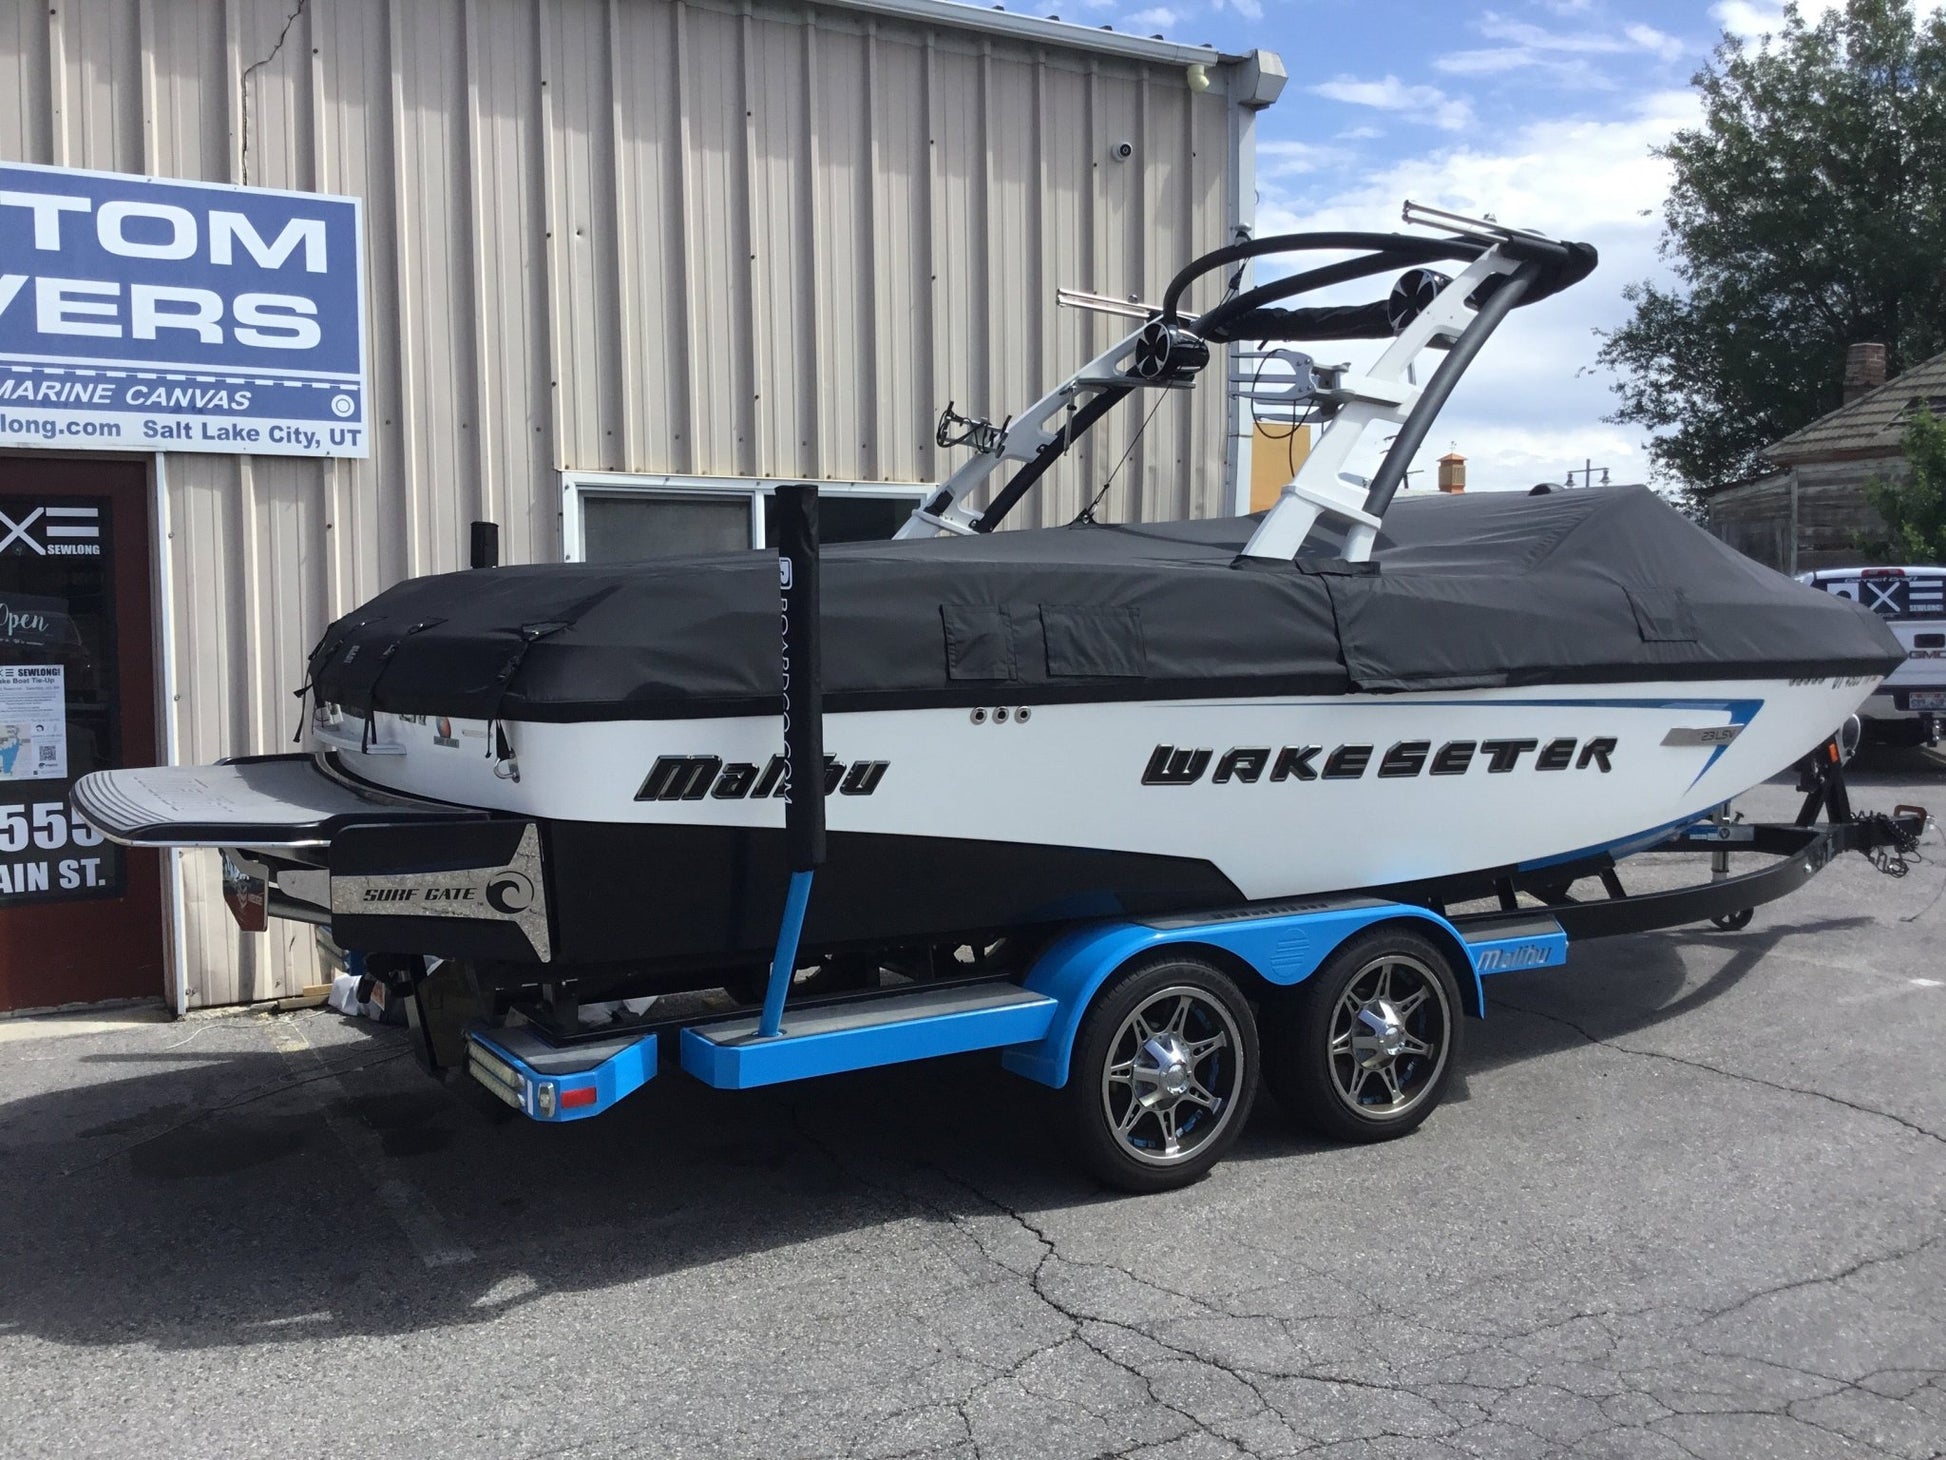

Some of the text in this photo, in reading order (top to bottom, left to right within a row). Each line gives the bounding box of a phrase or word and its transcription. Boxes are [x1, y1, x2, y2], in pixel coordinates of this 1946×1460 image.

[126, 385, 251, 410] CANVAS
[143, 420, 192, 439] Salt
[201, 422, 260, 442] Lake
[269, 425, 321, 448] City,
[330, 428, 361, 446] UT
[47, 544, 100, 555] SEWLONG
[59, 858, 106, 889] ST.
[363, 888, 419, 901] SURF
[425, 888, 477, 900] GATE
